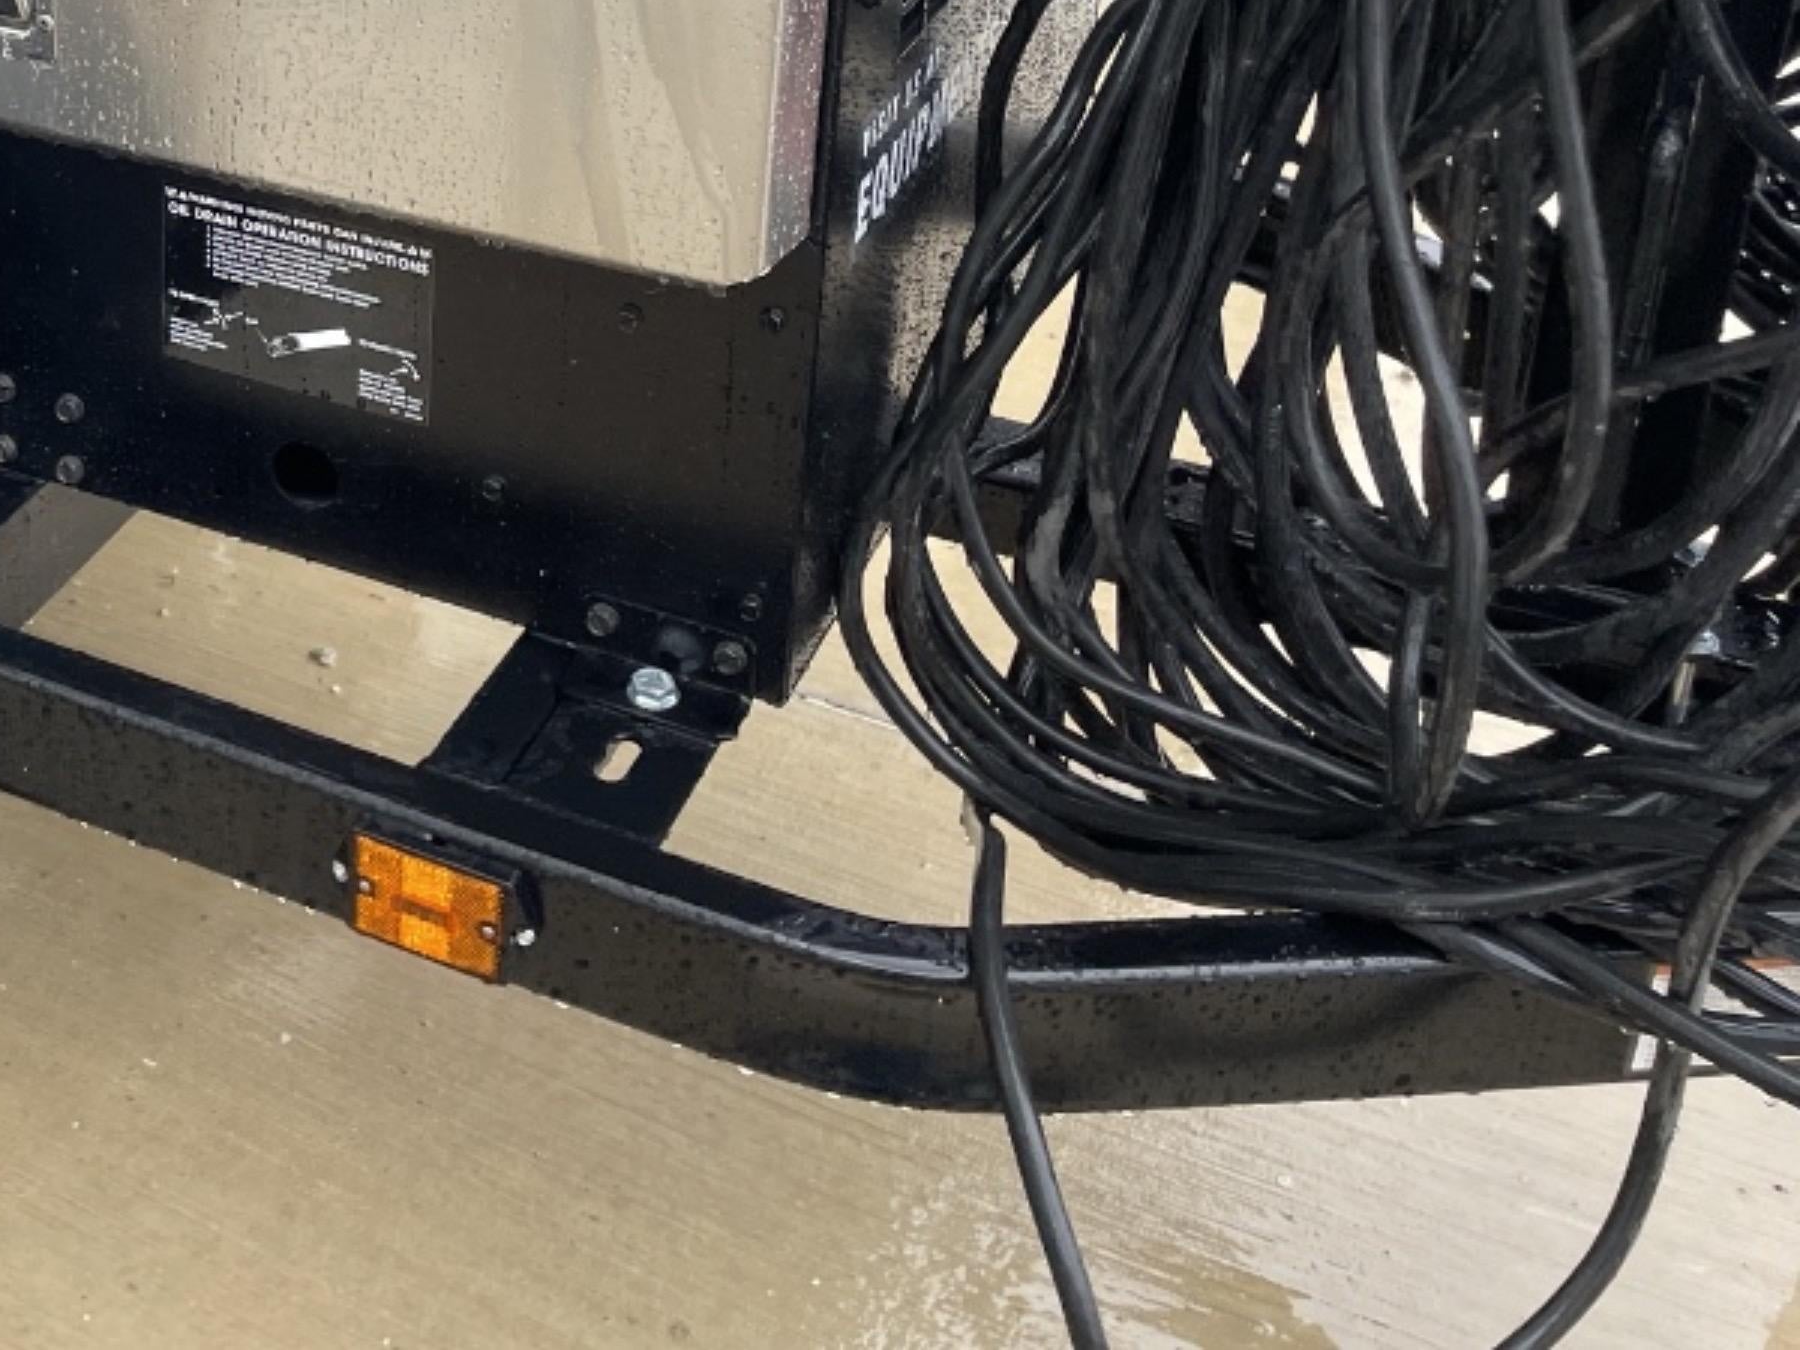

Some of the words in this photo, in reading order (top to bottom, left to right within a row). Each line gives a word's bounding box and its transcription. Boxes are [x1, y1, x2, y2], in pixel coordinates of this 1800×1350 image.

[194, 207, 238, 229] DRAIN
[242, 218, 322, 250] OPERATION
[326, 238, 430, 276] INSTRUCTIONS
